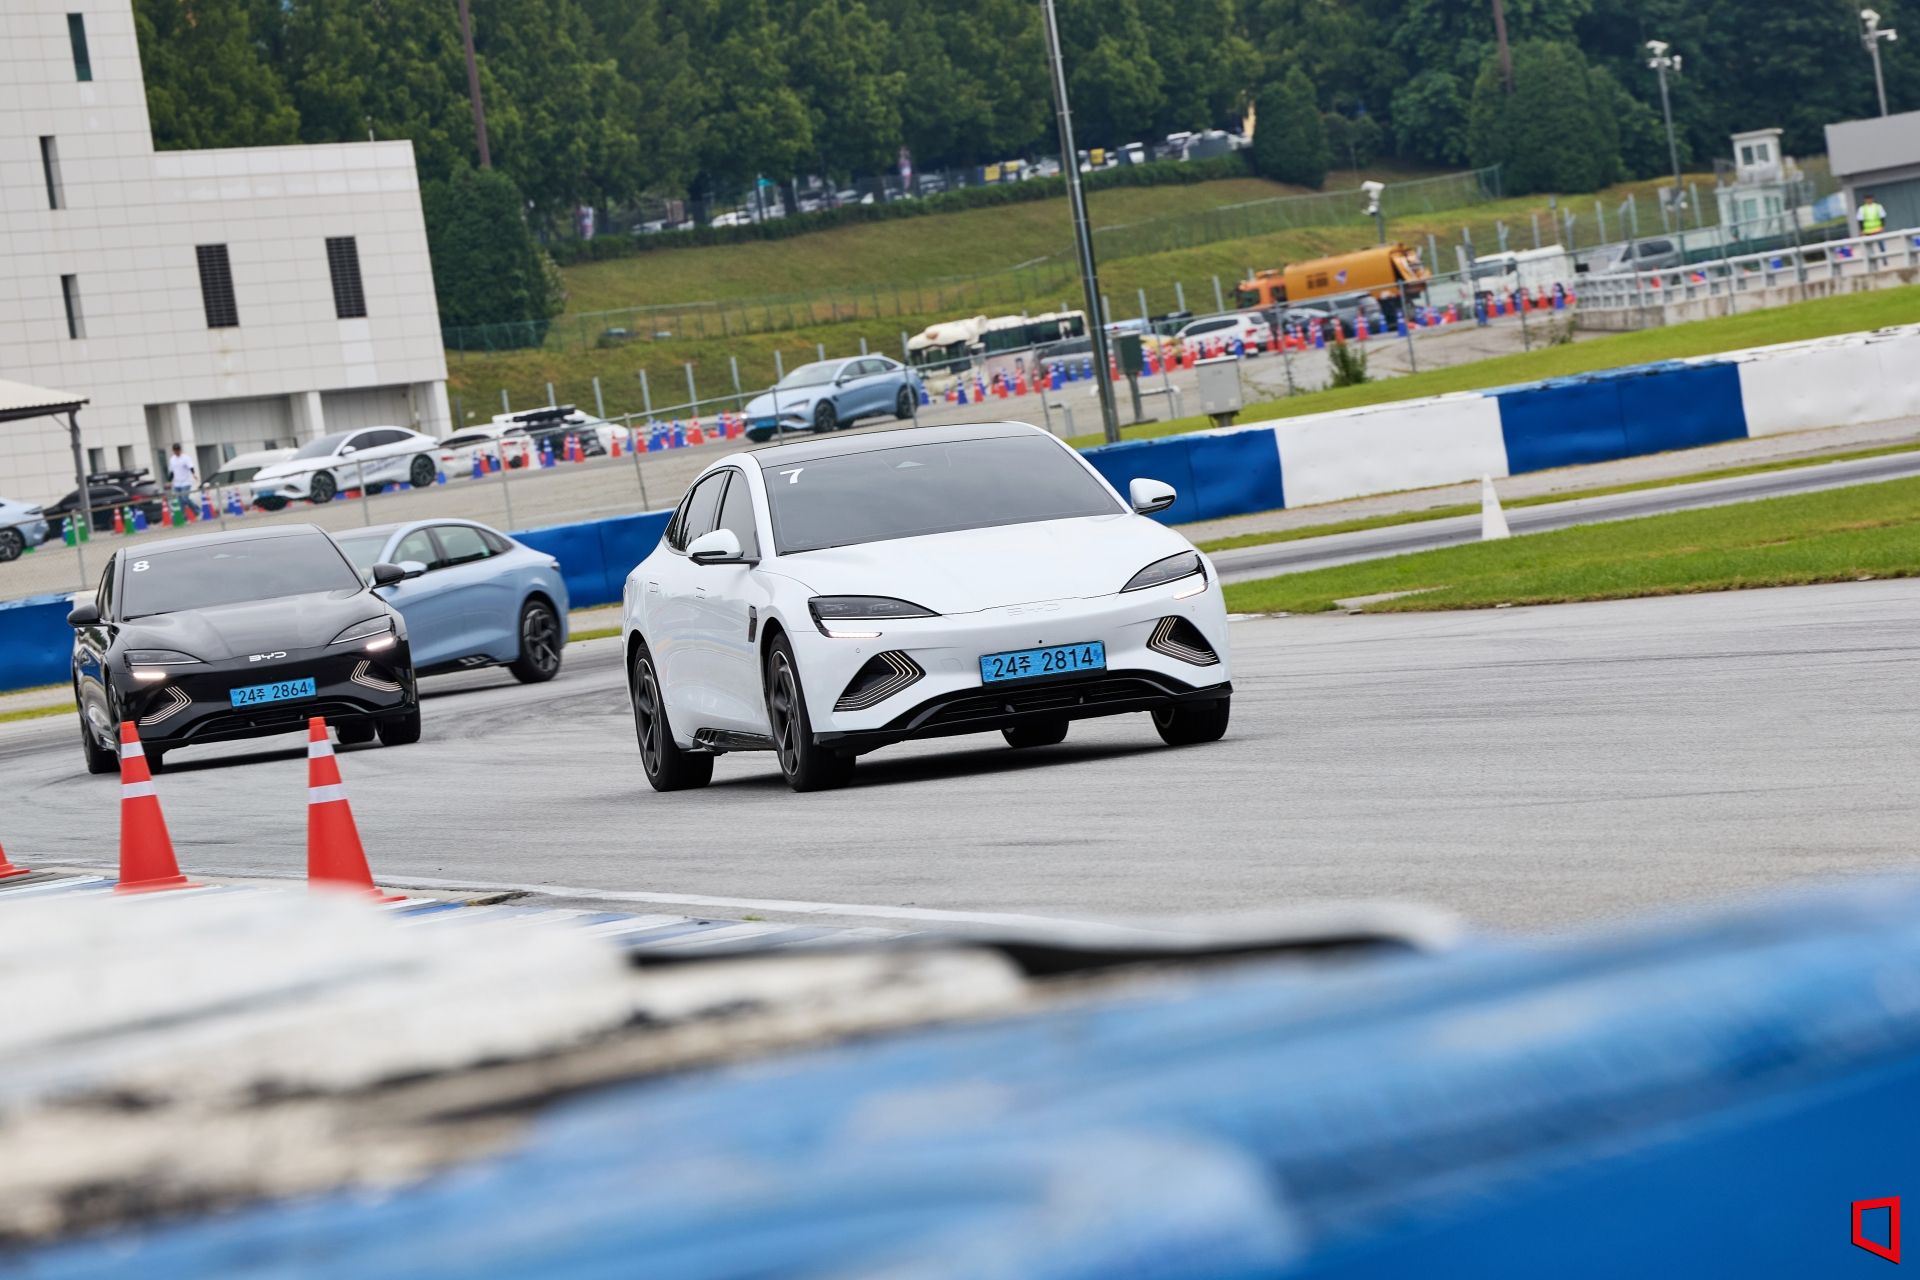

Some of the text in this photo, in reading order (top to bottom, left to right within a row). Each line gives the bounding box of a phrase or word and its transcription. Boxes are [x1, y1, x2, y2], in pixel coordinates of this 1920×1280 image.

[779, 467, 804, 485] 7
[132, 560, 150, 573] 8
[249, 651, 287, 662] BYD
[992, 647, 1094, 678] 24주 2814
[238, 681, 308, 704] 24주 2864
